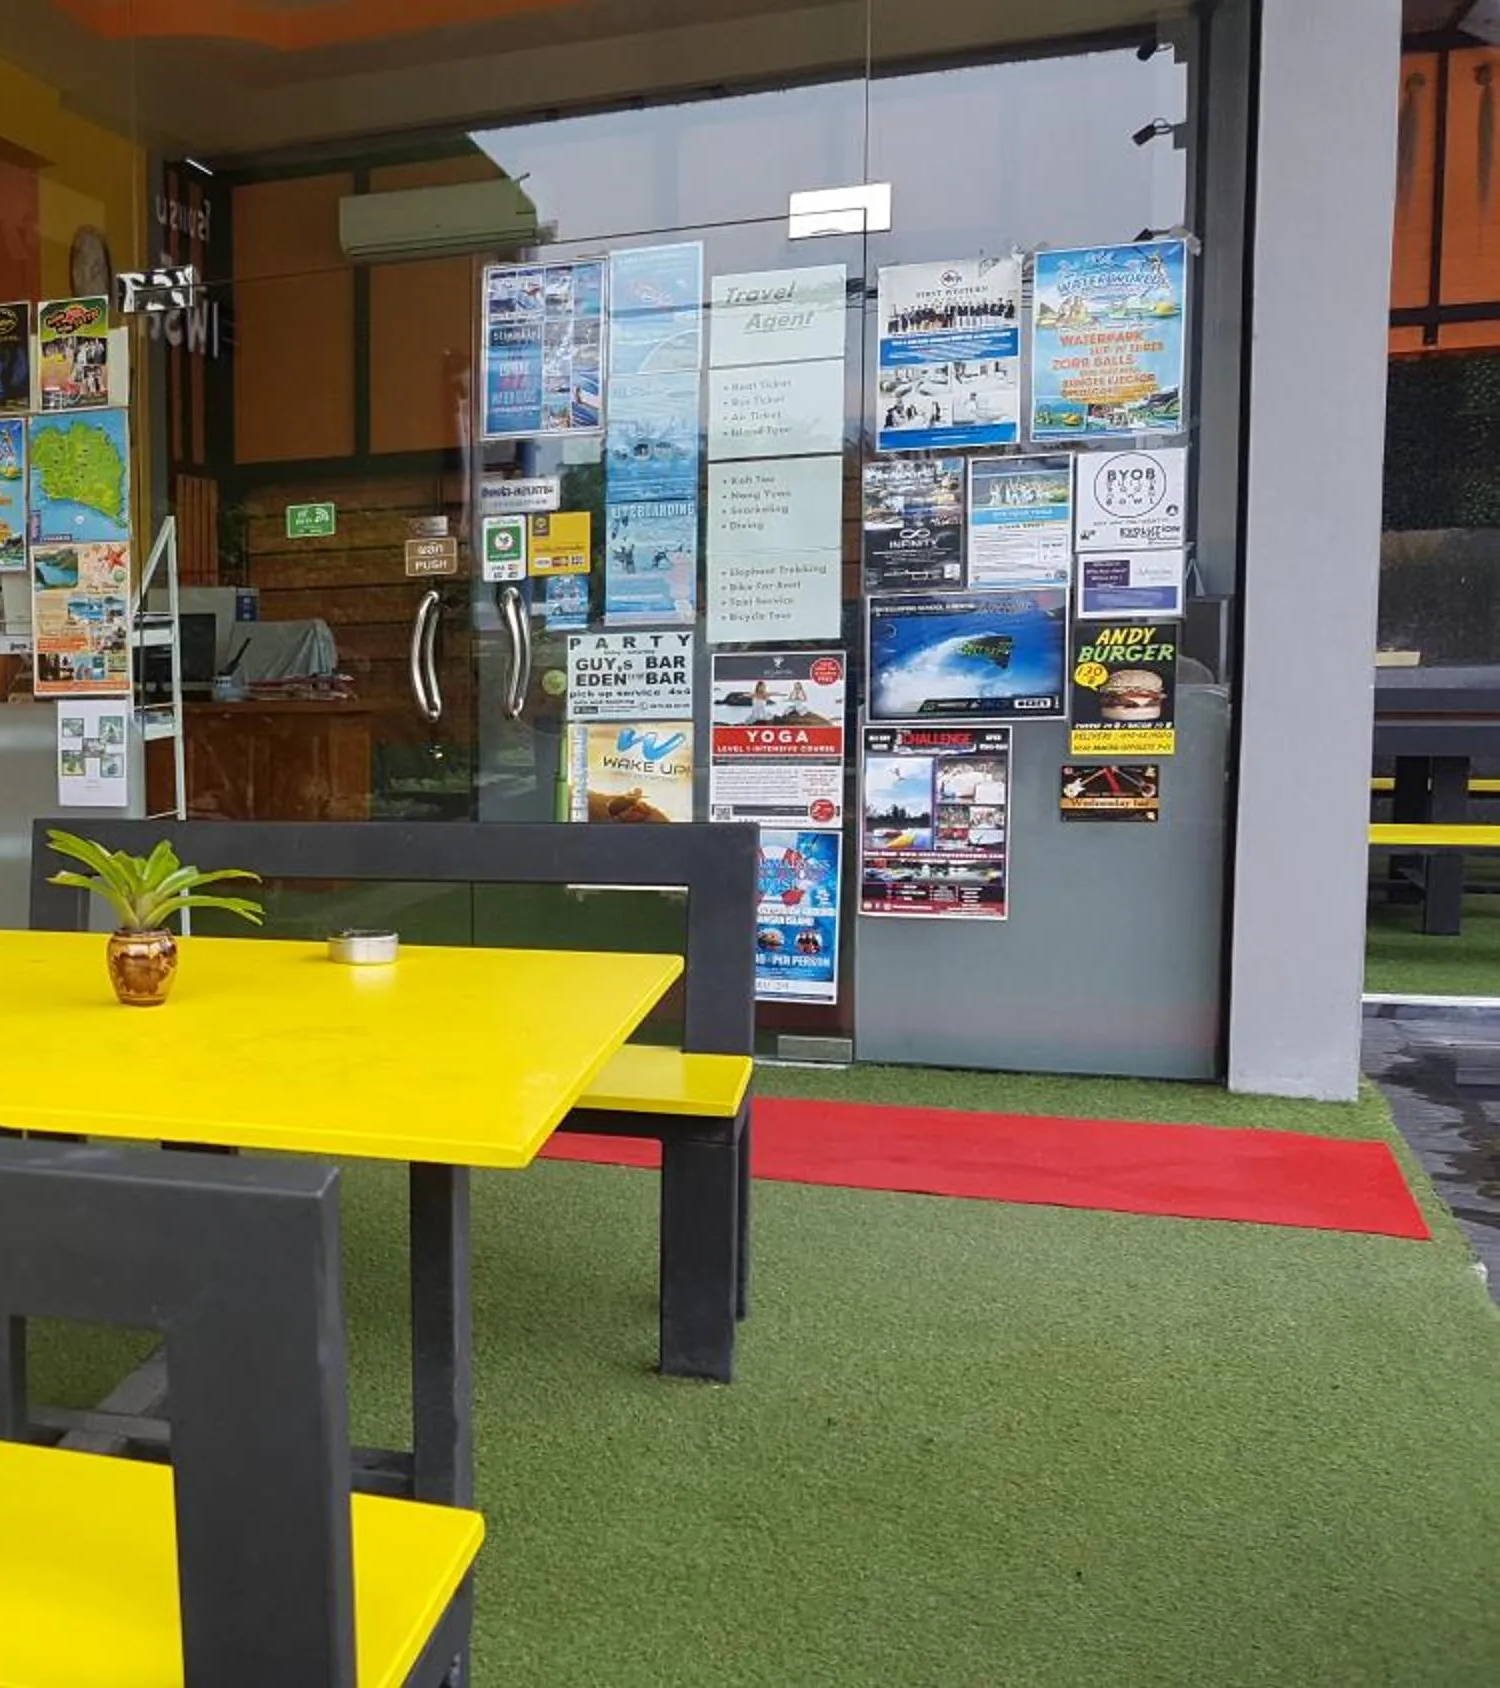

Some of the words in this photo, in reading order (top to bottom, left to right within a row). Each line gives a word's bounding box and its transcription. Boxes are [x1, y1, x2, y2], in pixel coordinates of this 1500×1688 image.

[725, 280, 797, 304] Travel
[916, 290, 942, 298] FIRST
[744, 311, 815, 332] Agent
[1060, 331, 1144, 346] WATERPARK
[1094, 354, 1135, 368] BALLS
[760, 379, 791, 390] Ticket
[754, 394, 785, 405] Ticket
[750, 411, 781, 420] Ticket
[1107, 468, 1156, 481] BYOB
[889, 539, 938, 549] INFINITY
[415, 559, 448, 571] PUSH
[570, 634, 691, 650] PARTY
[1096, 627, 1156, 645] ANDY
[1078, 644, 1174, 663] BURGER
[646, 656, 686, 669] BAR
[576, 673, 627, 686] EDEN
[646, 672, 686, 685] BAR
[570, 689, 595, 698] pick
[617, 689, 661, 697] service
[746, 730, 810, 743] YOGA
[901, 732, 974, 745] CHALLENGE
[717, 745, 745, 753] LEVEL
[799, 745, 836, 753] COURSE
[603, 756, 654, 773] WAKE
[660, 764, 692, 778] UP!
[773, 954, 791, 966] PER
[792, 956, 831, 968] PERSON
